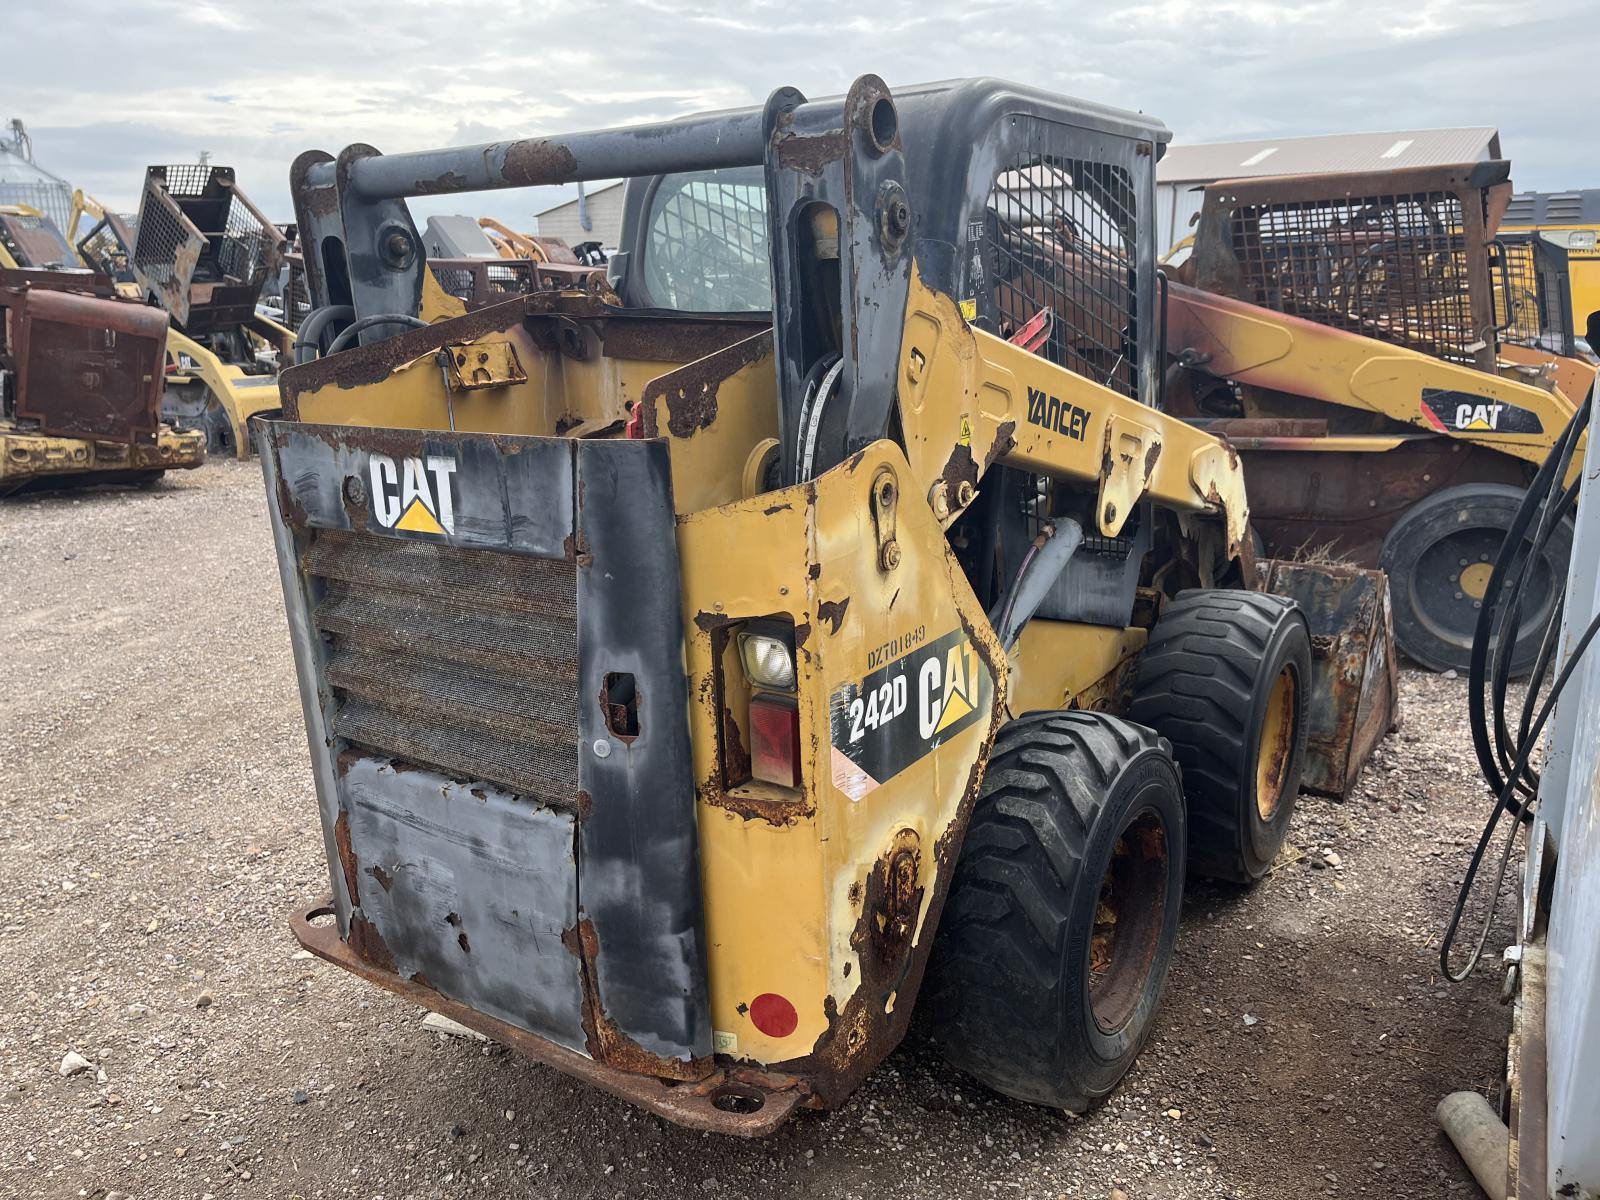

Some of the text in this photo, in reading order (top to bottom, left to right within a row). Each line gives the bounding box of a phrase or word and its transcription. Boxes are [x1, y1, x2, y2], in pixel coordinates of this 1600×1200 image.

[1027, 386, 1091, 442] YANCEY
[1455, 403, 1502, 430] CAT
[369, 454, 457, 536] CAT
[868, 624, 925, 670] DZT01849
[849, 674, 907, 744] 242D
[919, 639, 979, 740] CAT
